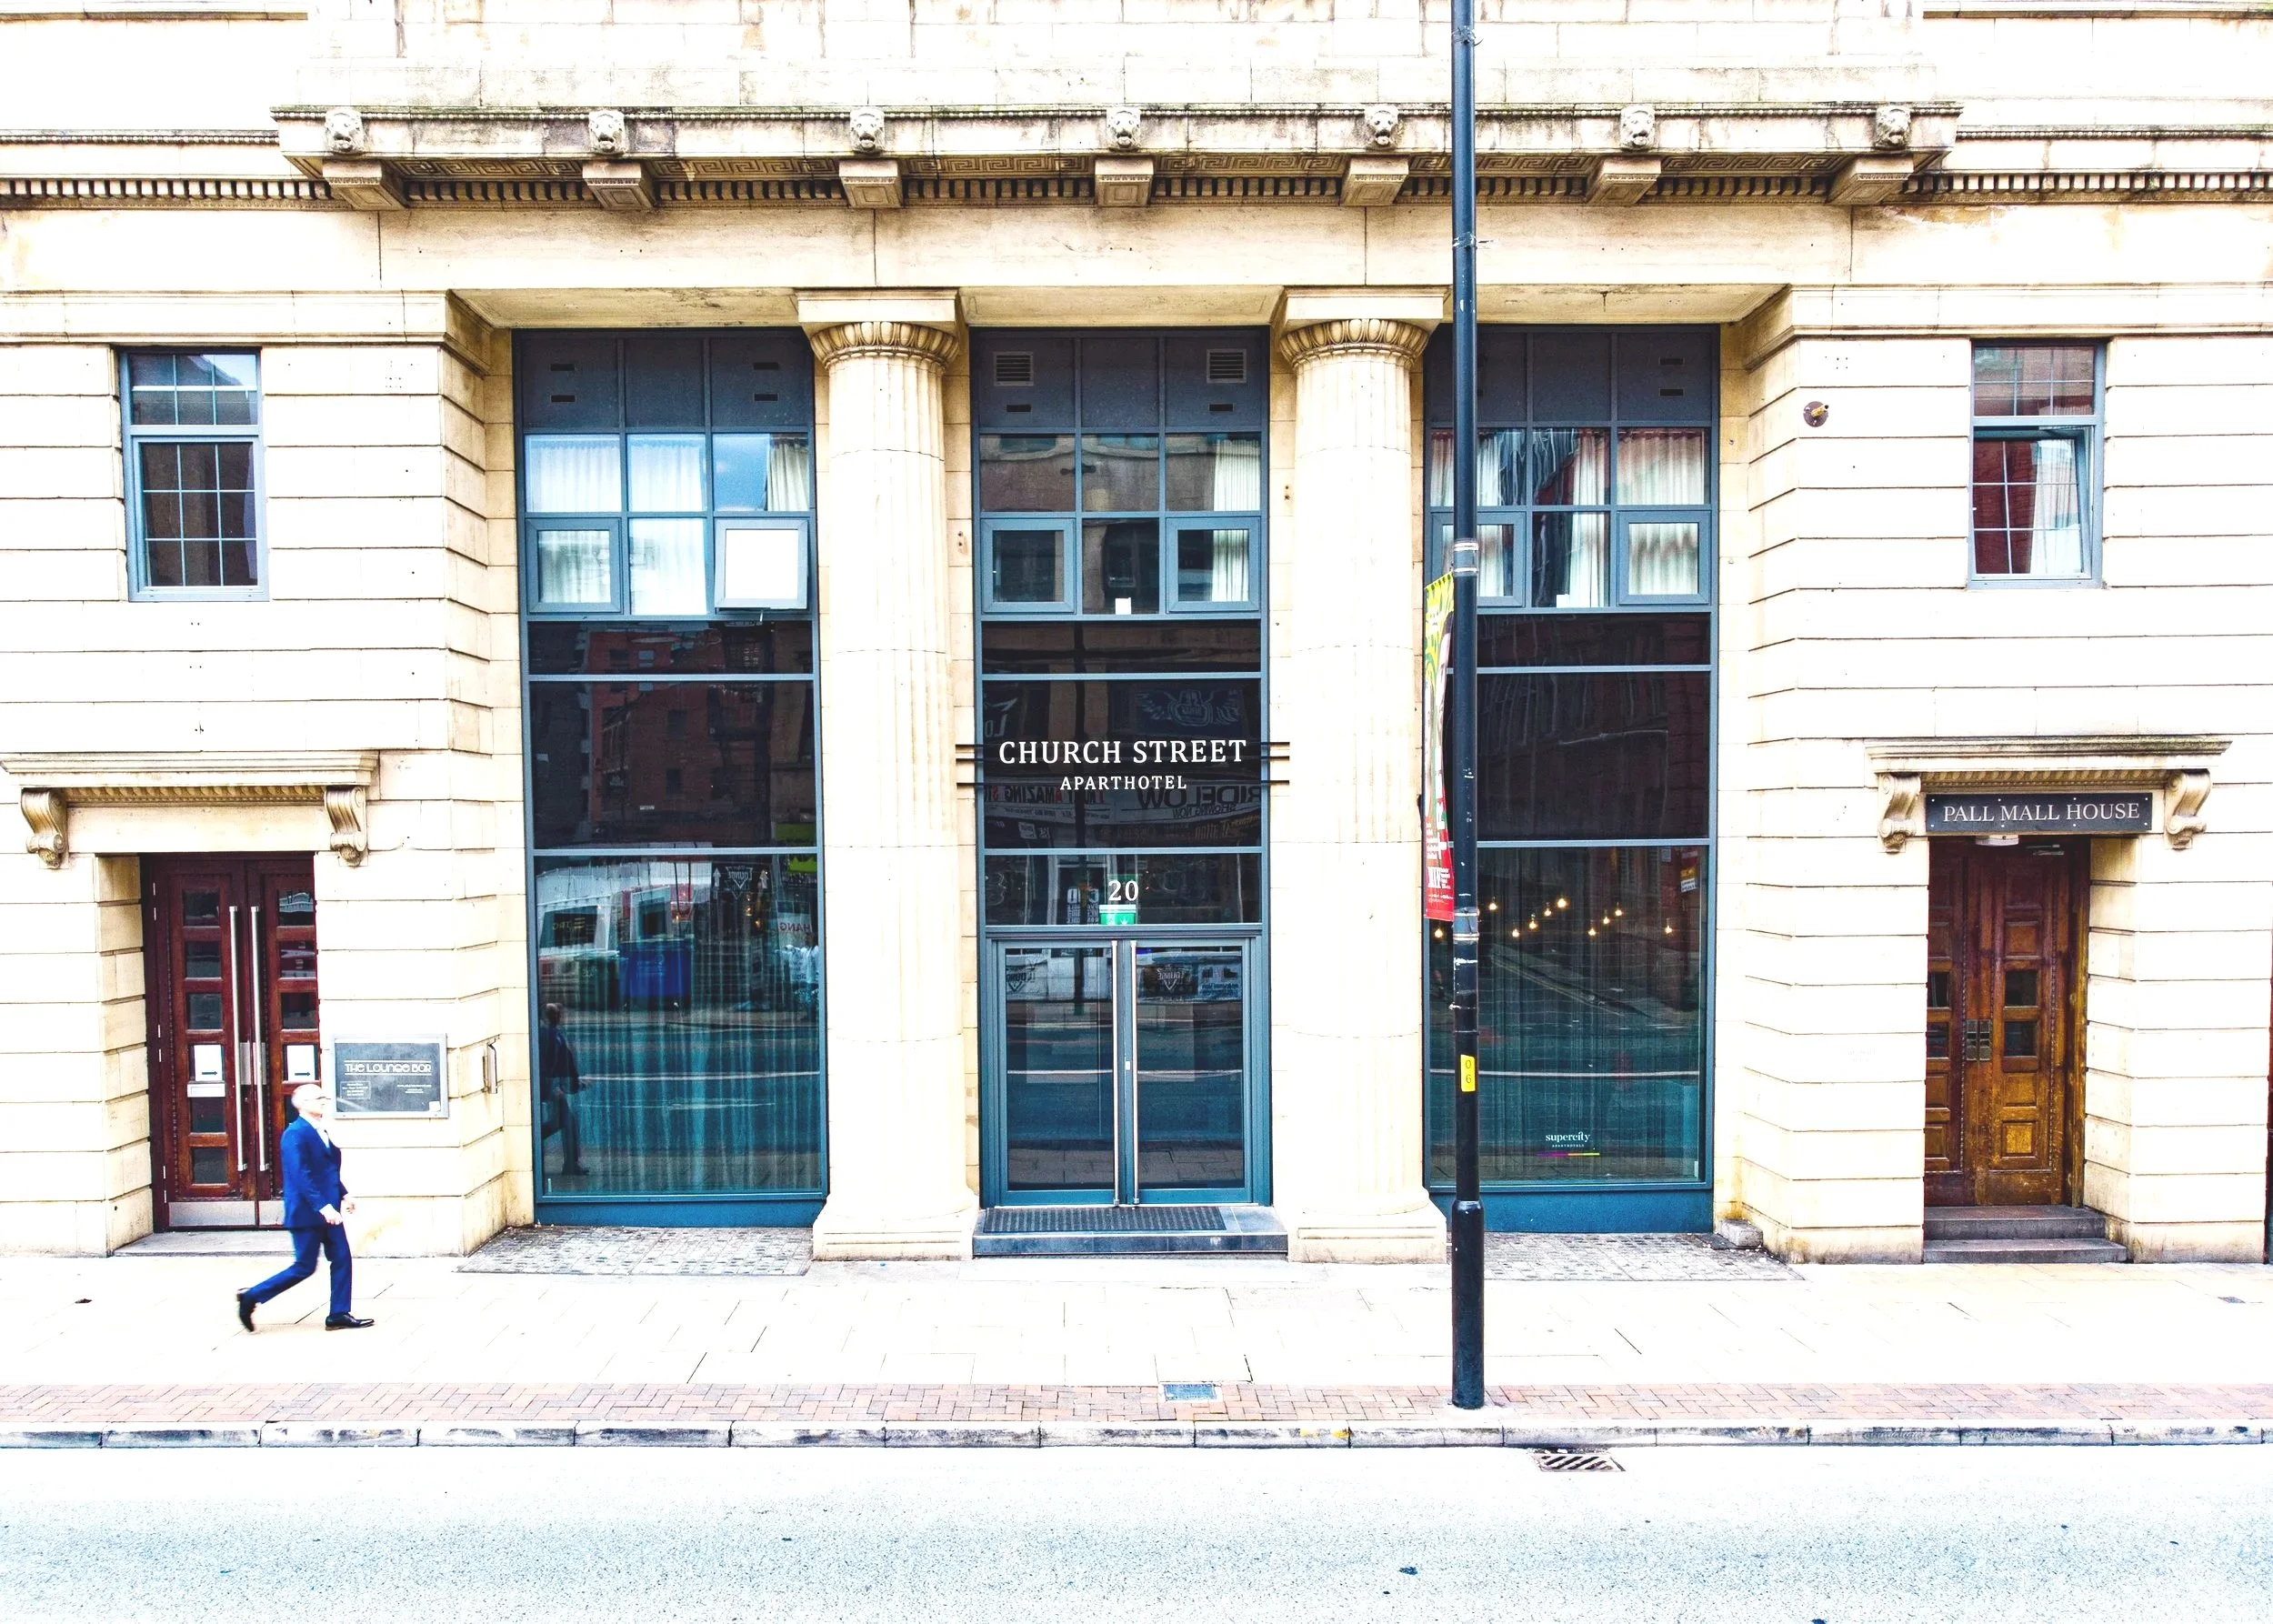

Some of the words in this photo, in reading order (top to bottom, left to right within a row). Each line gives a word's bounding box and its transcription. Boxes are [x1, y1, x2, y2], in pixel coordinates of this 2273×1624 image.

[999, 740, 1121, 764] CHURCH
[1133, 739, 1247, 764] STREET
[1060, 776, 1187, 790] APARTHOTEL
[1943, 806, 1995, 822] PALL
[2000, 805, 2059, 821] MALL
[2066, 803, 2140, 819] HOUSE
[1107, 879, 1139, 901] 20
[345, 1063, 365, 1073] THE
[1546, 1131, 1591, 1143] supercity
